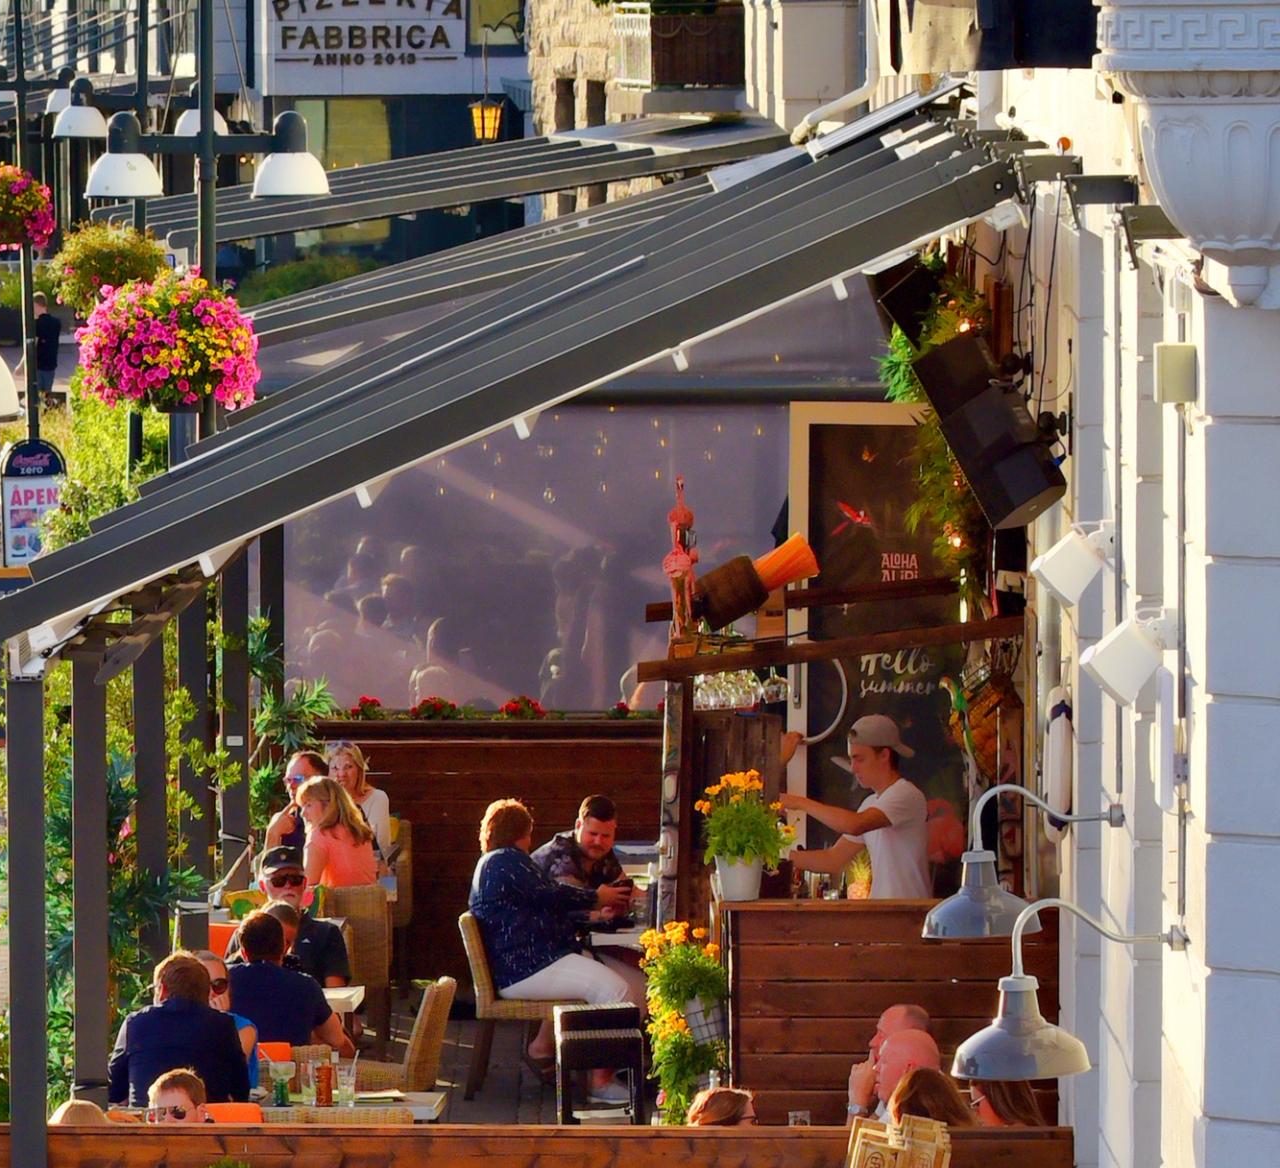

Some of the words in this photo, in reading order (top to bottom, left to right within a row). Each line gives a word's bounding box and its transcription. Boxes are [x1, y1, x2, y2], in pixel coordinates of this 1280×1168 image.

[273, 0, 462, 21] PIZIA
[282, 25, 451, 50] FABBRICA
[313, 53, 365, 66] ANNO
[20, 466, 44, 475] zero
[10, 484, 59, 506] ÅPEN
[881, 553, 919, 569] ALOHA
